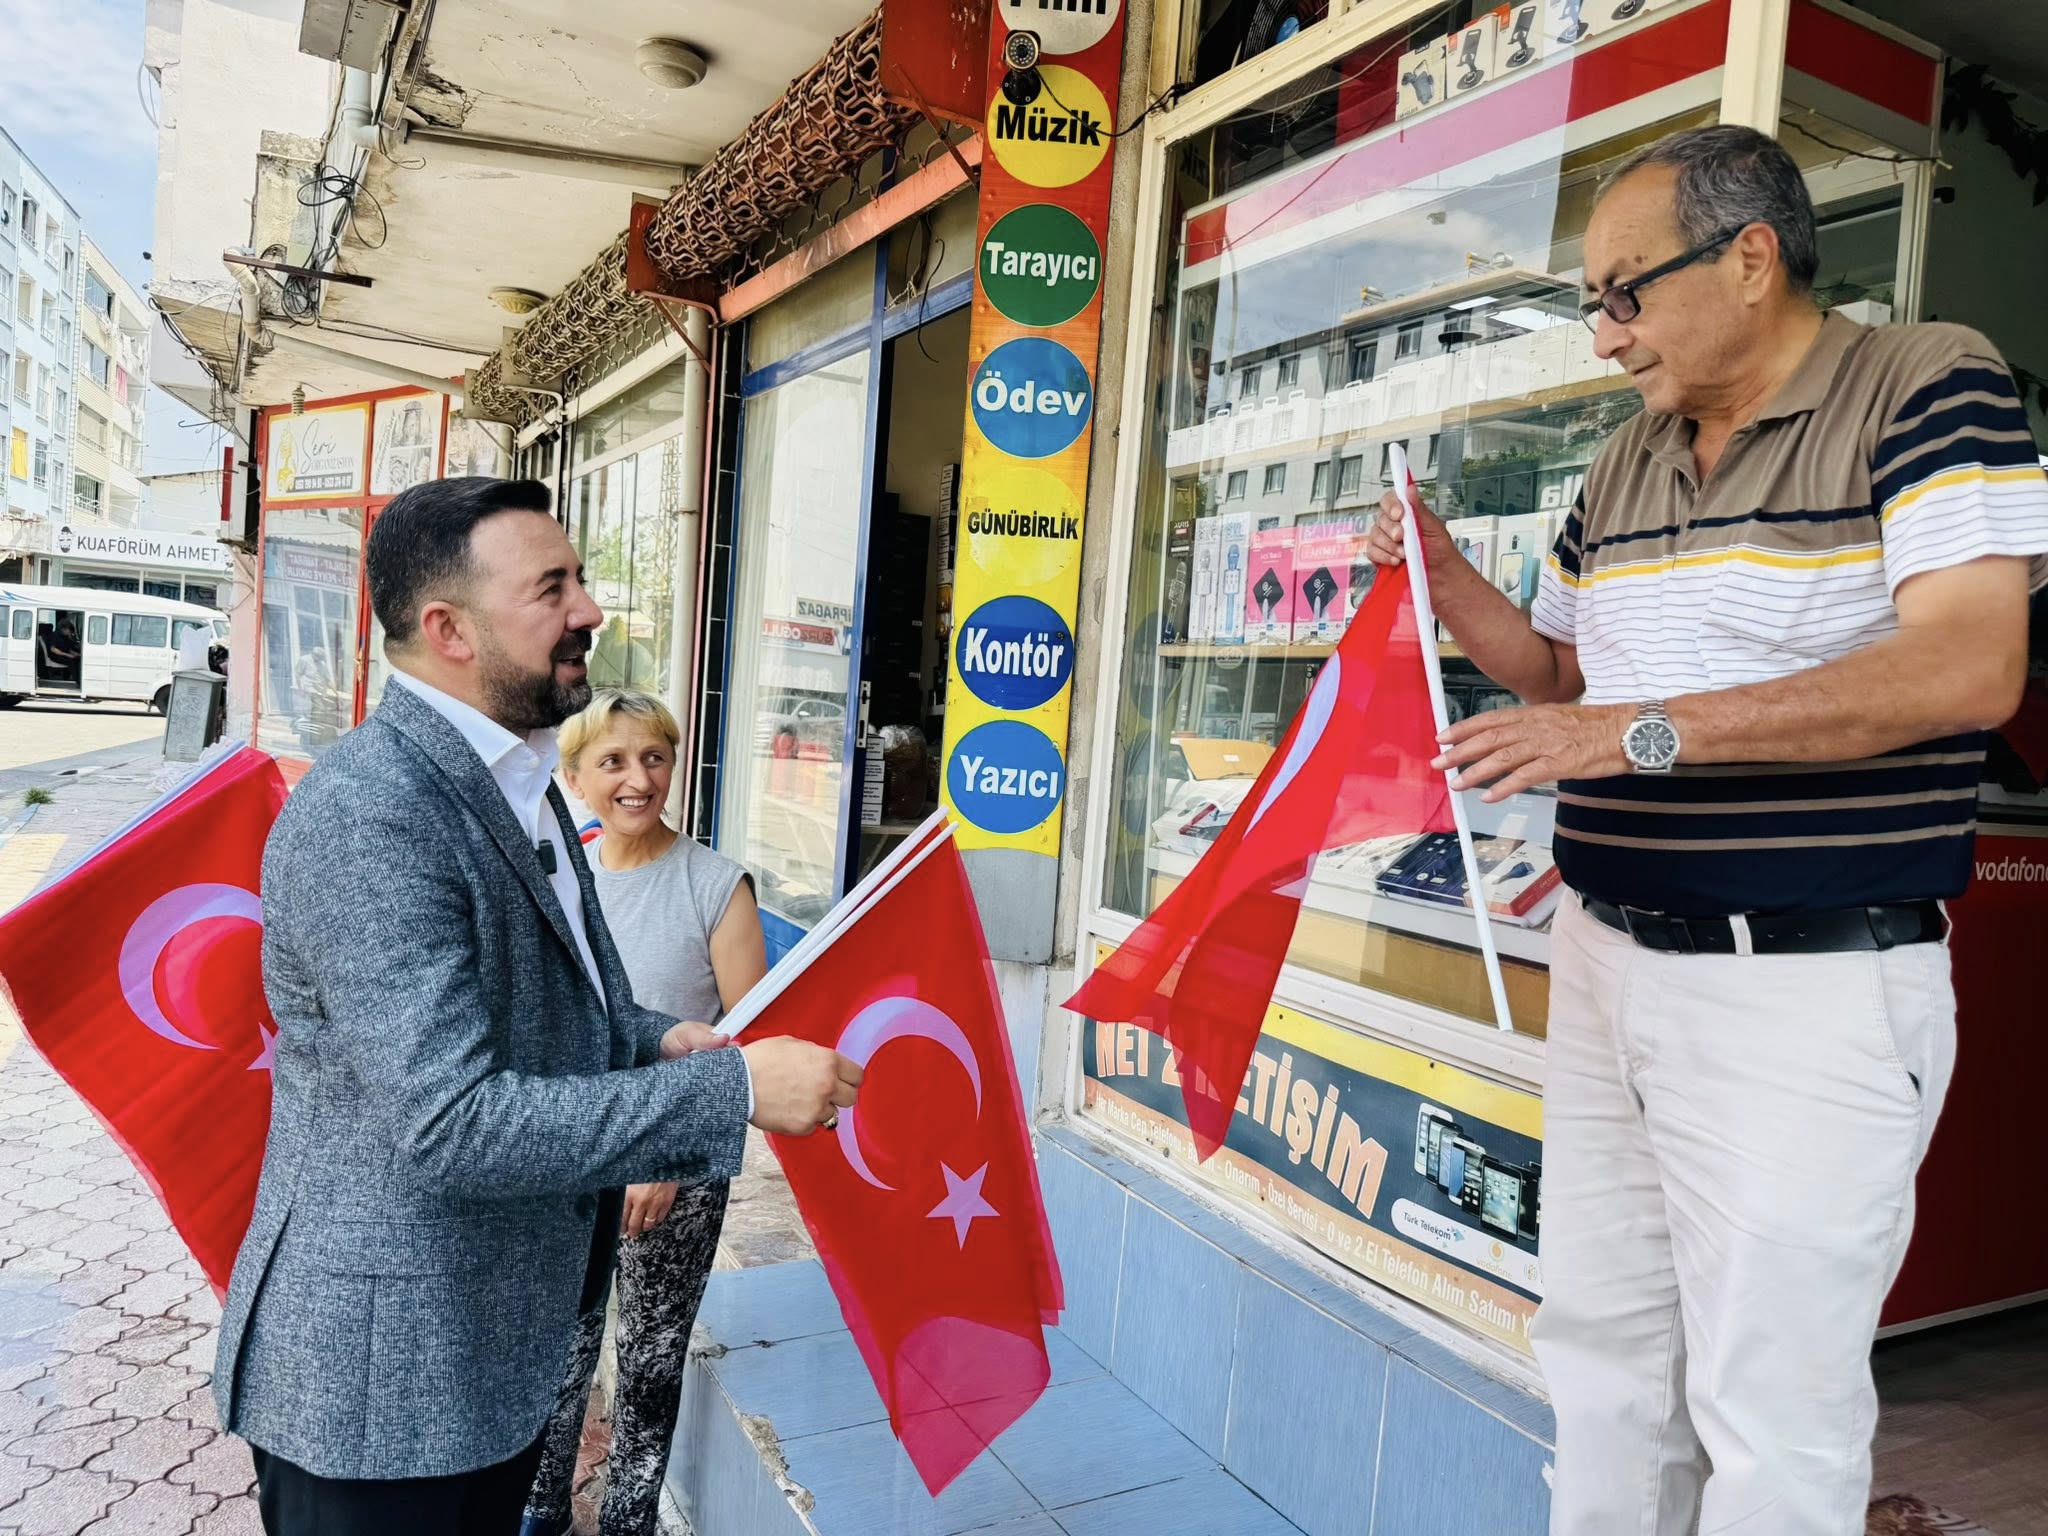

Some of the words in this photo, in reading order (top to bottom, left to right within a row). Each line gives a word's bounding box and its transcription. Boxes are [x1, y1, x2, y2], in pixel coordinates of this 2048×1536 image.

[995, 104, 1101, 146] Müzik
[986, 241, 1096, 287] Tarayıcı
[976, 370, 1088, 416] Ödev
[967, 508, 1080, 540] GÜNÜBİRLİK
[77, 535, 162, 558] KUAFÖRÜM
[166, 545, 220, 563] AHMET
[964, 627, 1065, 678] Kontör
[959, 754, 1059, 799] Yazıcı
[1096, 1017, 1153, 1078] NET
[1403, 1211, 1419, 1228] Türk
[1420, 1218, 1451, 1241] Telekom
[1267, 1178, 1286, 1214] Özel
[1382, 1247, 1429, 1290] Telefon
[1432, 1272, 1465, 1308] Alım
[1468, 1289, 1517, 1333] Satımı
